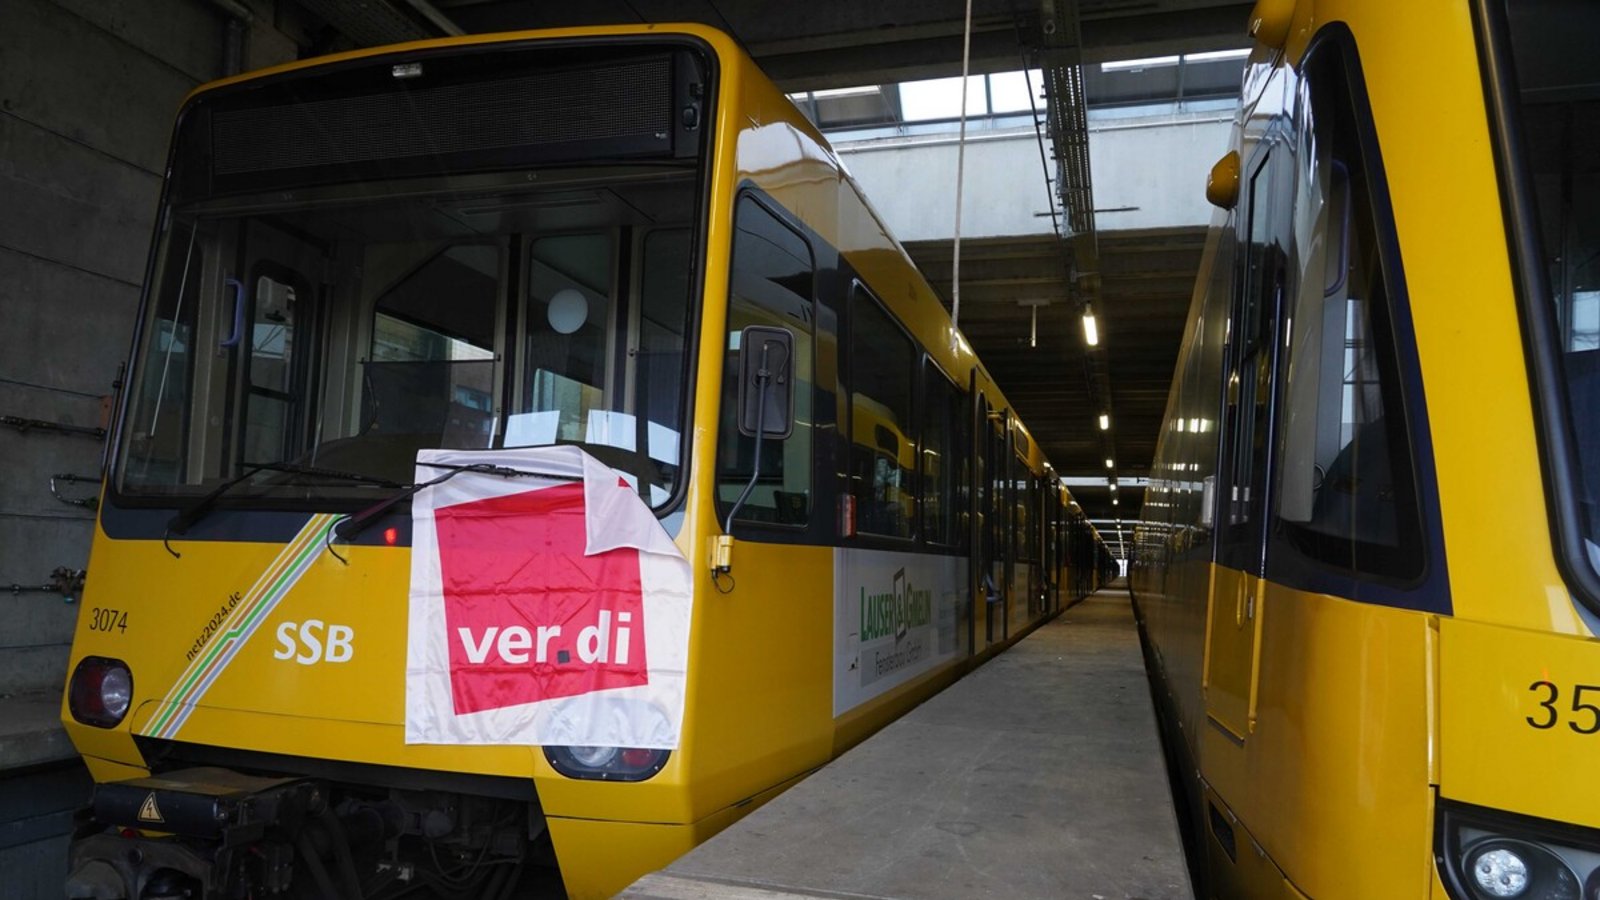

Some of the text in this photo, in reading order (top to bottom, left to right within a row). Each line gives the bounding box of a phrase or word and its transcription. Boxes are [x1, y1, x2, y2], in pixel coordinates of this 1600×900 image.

[89, 607, 128, 634] 3074
[186, 590, 242, 661] netz2024.de
[274, 619, 354, 665] SSB
[458, 610, 631, 665] ver.di
[1526, 680, 1600, 734] 35
